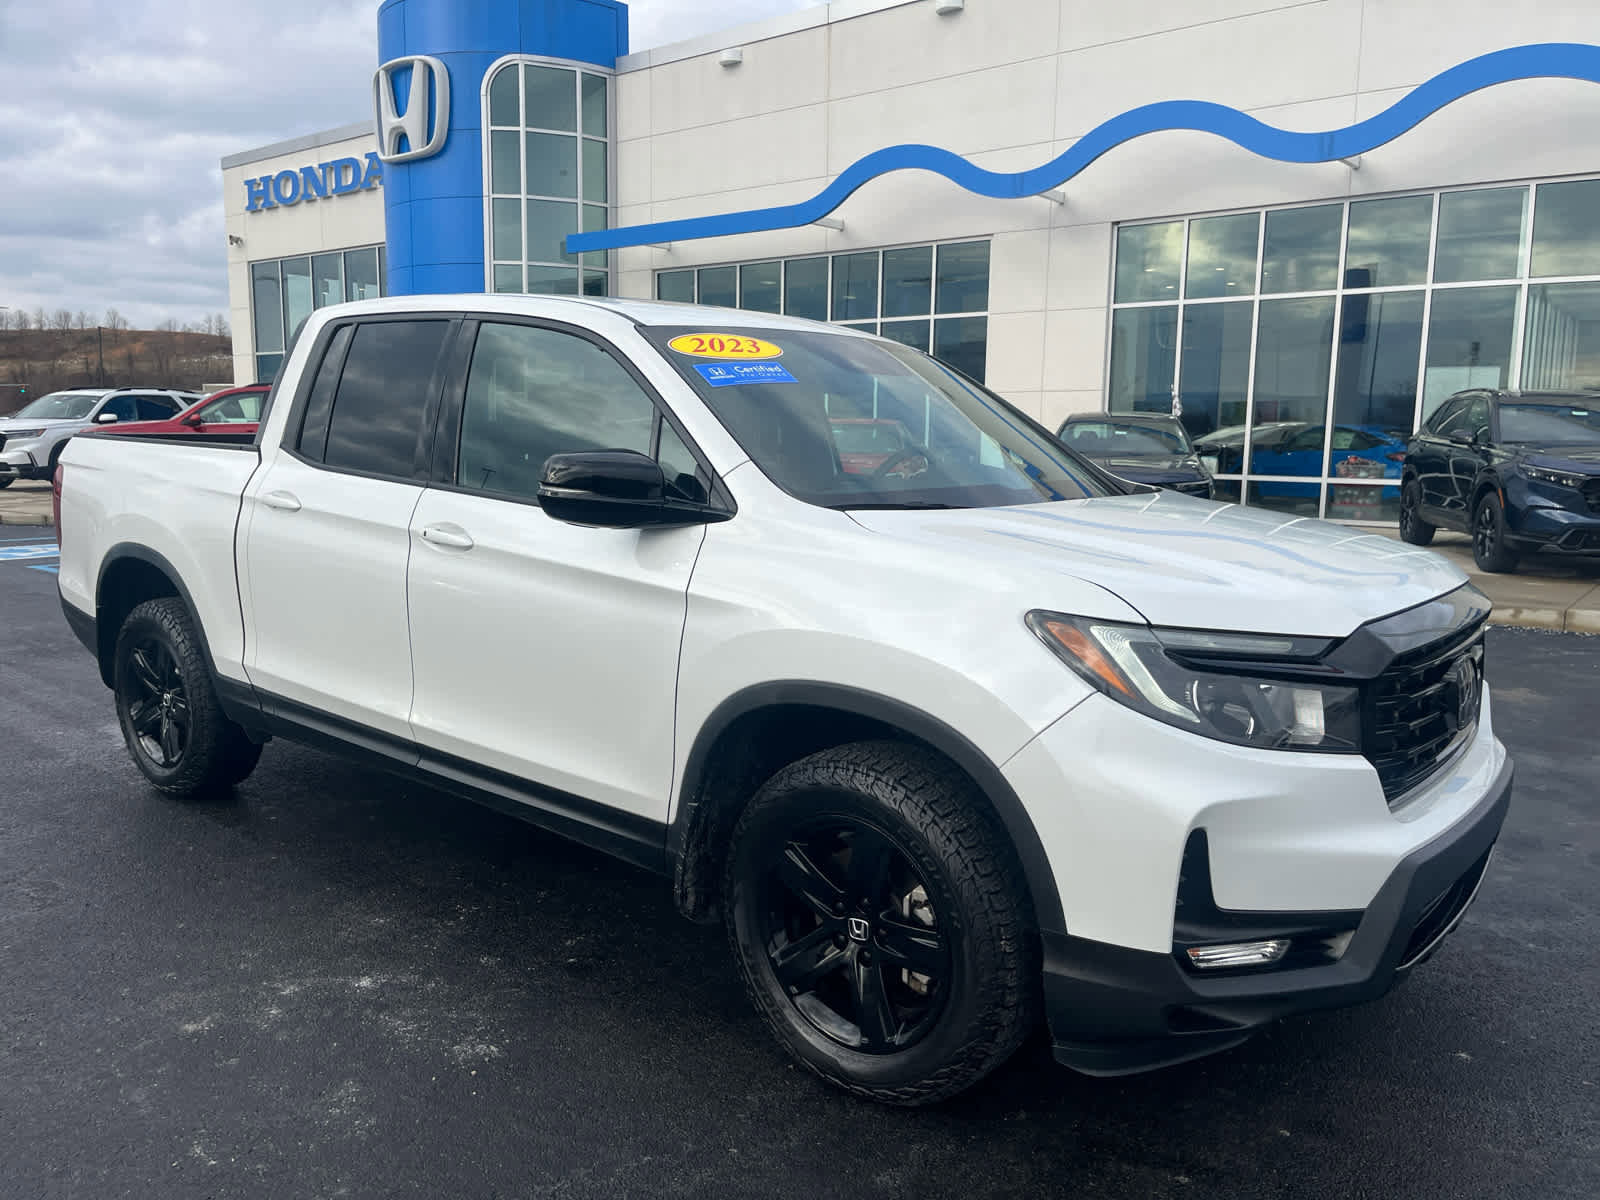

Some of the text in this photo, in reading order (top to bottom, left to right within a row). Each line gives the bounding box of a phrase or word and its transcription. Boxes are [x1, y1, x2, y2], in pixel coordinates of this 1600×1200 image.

[244, 152, 384, 211] HONDA
[690, 337, 761, 353] 2023
[734, 365, 782, 373] Certified
